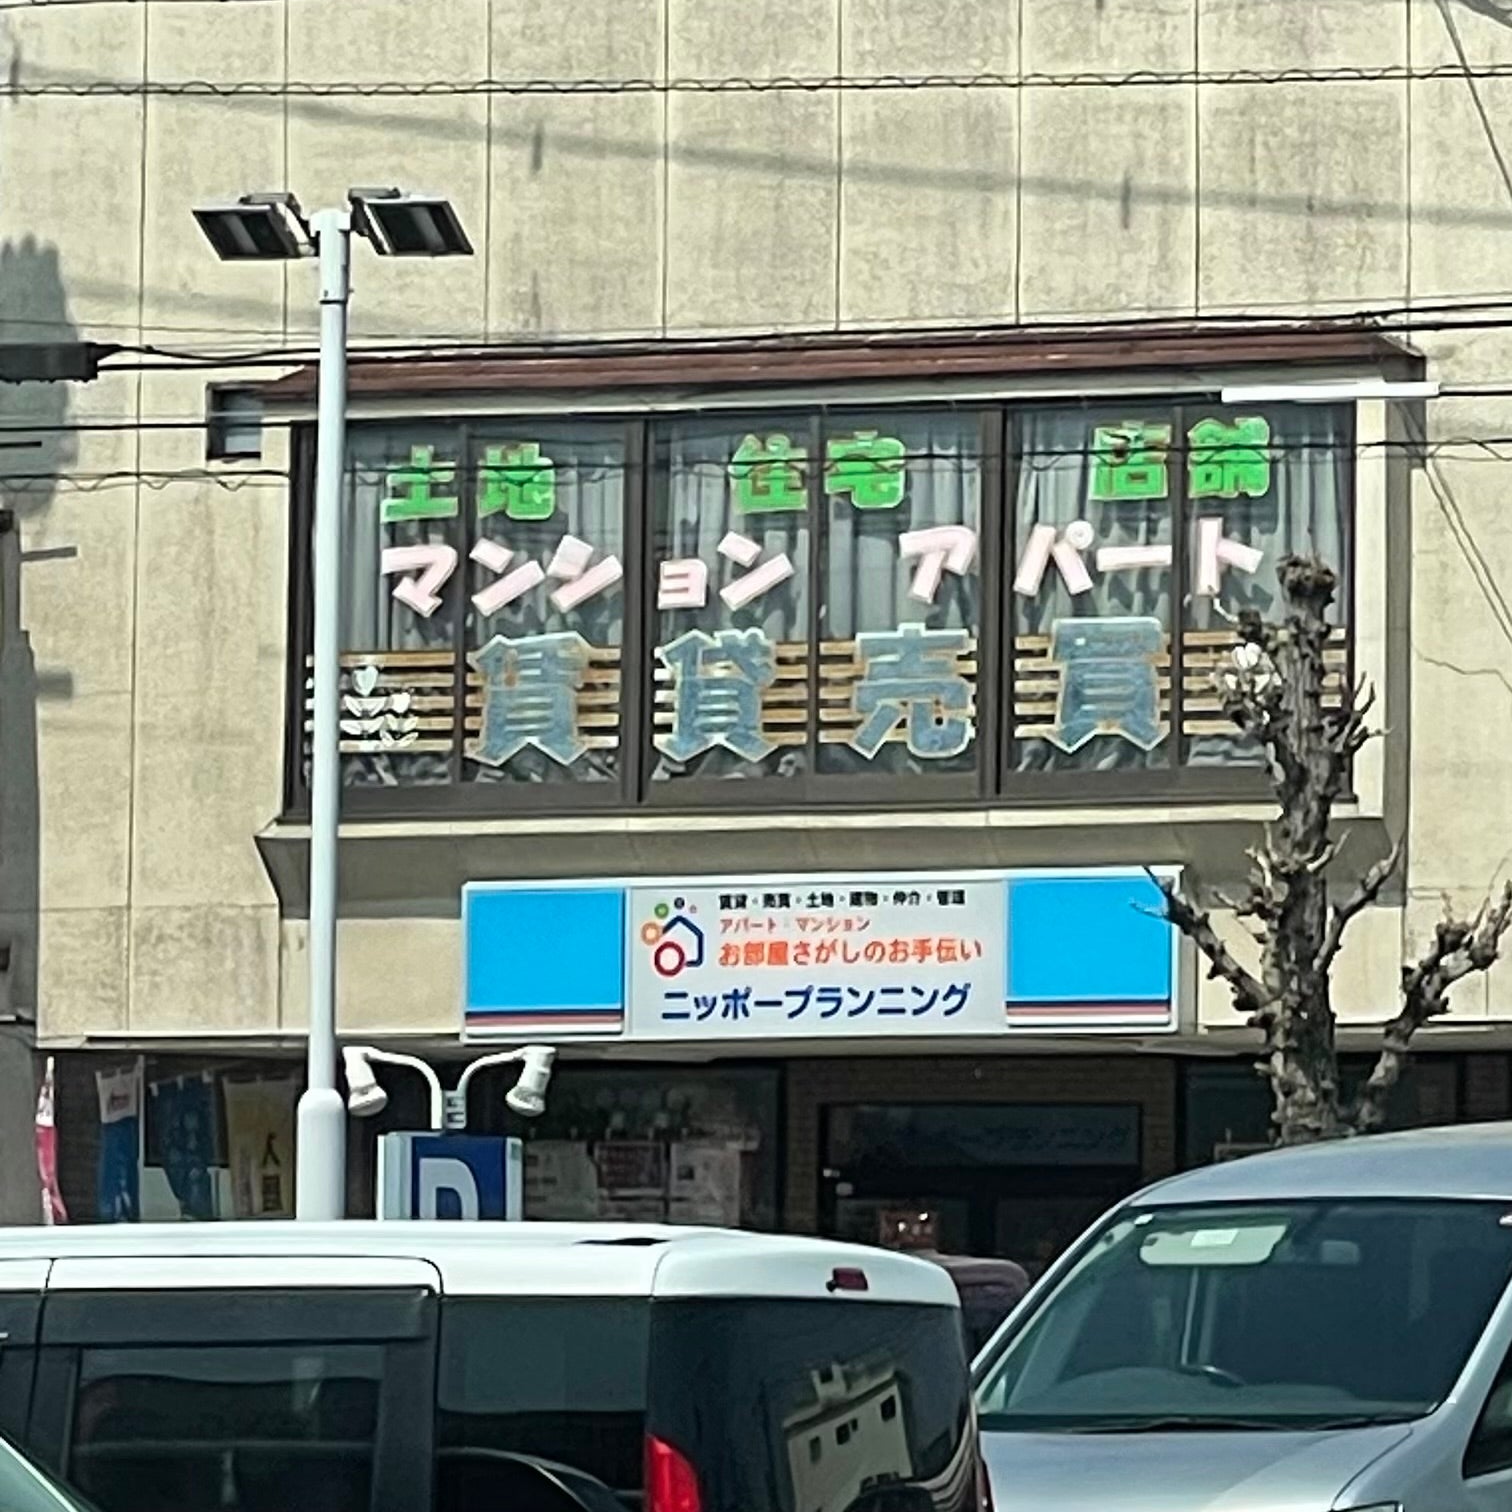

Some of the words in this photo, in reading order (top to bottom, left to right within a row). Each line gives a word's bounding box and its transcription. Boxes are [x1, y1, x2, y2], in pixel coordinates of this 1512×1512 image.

[380, 443, 555, 522] 土地
[728, 431, 905, 515] 住宅
[381, 531, 795, 617] マンション
[900, 517, 1264, 604] アパート
[466, 628, 778, 767] 賃貸
[847, 618, 1172, 760] 売買
[718, 937, 983, 967] お部屋さがしのお手伝い
[661, 982, 972, 1021] ニッポープランニング
